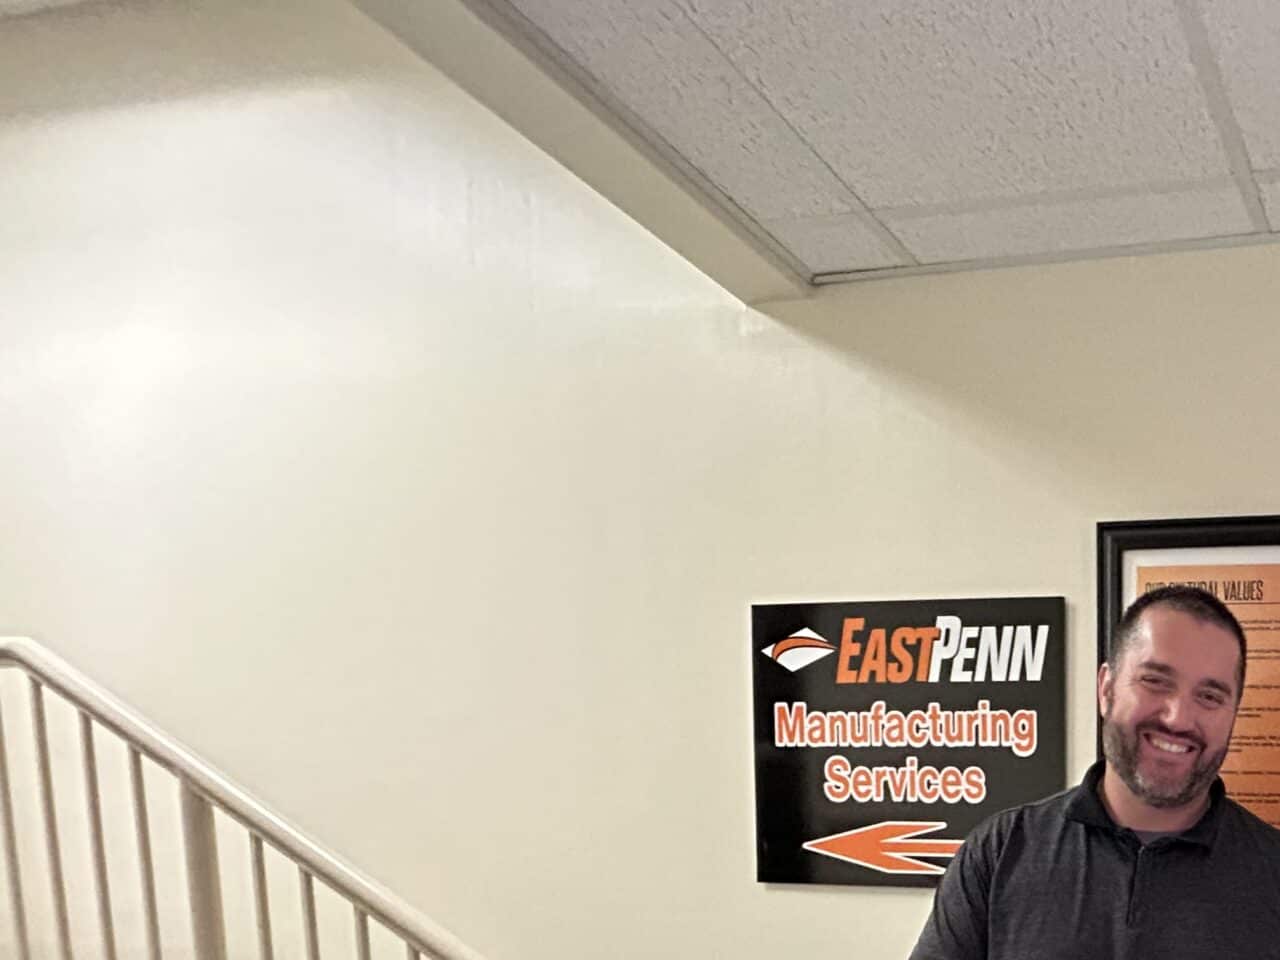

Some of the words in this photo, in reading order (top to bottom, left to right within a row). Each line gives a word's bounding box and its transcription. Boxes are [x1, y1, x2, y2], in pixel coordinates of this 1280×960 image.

[1223, 579, 1265, 601] VALUES
[773, 700, 1037, 757] Manufacturing
[824, 755, 986, 803] Services
